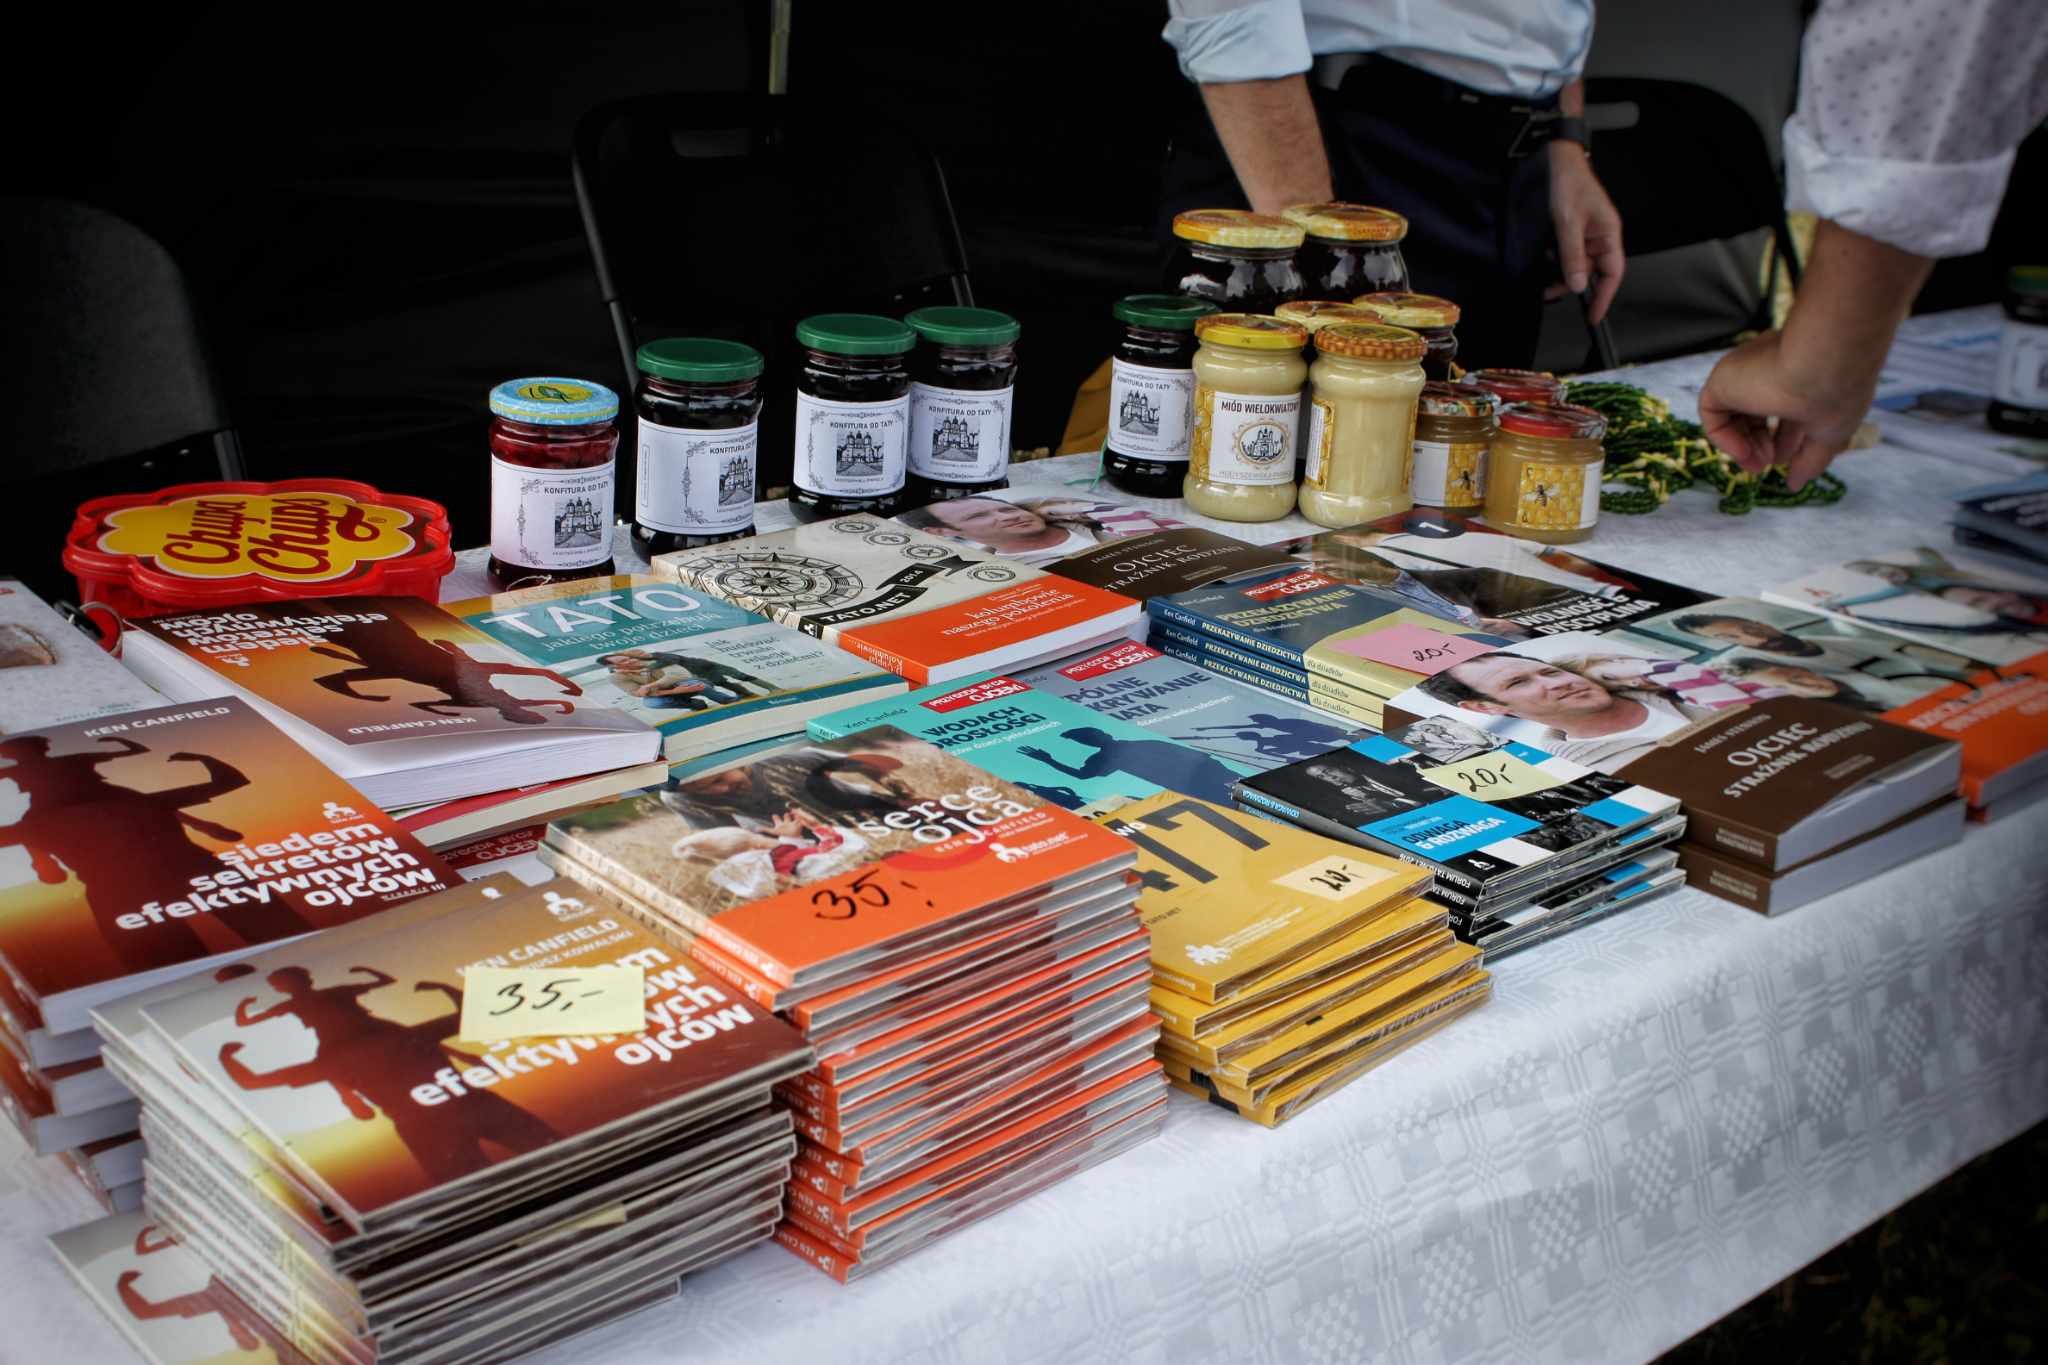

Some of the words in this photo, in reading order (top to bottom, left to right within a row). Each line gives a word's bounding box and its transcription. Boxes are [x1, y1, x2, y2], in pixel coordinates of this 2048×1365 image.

[1155, 383, 1171, 391] TATY
[928, 405, 965, 416] KONFITURA
[977, 408, 992, 416] TATY
[1221, 401, 1242, 414] MIÓD
[830, 421, 868, 429] KONFITURA
[709, 445, 745, 455] KONFITURA
[544, 486, 587, 495] KONFITURA
[163, 500, 267, 565] Chupa
[247, 498, 380, 575] Chups
[1113, 544, 1197, 572] OJCIEC
[900, 569, 924, 584] 2014
[1104, 561, 1177, 592] TRAŻNIK
[480, 588, 701, 639] TATO
[820, 592, 912, 622] TATO.NET
[1216, 588, 1356, 621] PRZEKAZYWANIE
[1232, 602, 1348, 627] DZIEDZICTWA
[1510, 596, 1615, 627] WOLNOŚĆ
[1534, 599, 1661, 636] DYSCYPLINA
[160, 612, 258, 631] ojców
[172, 613, 388, 639] efektywnych
[187, 624, 344, 646] sekretów
[200, 635, 328, 654] siedem
[542, 629, 617, 651] jakiego
[589, 636, 644, 652] twoje
[1201, 621, 1257, 647] PRZEKAZYWANIE
[1256, 641, 1302, 664] DZIEDZICTWA
[1205, 642, 1260, 668] PRZEKAZYWANIE
[1260, 661, 1307, 684] DZIEDZICTWA
[1064, 675, 1149, 703] PÓLNE
[1085, 671, 1213, 712] KRYWANIE
[1204, 658, 1259, 684] PRZEKAZYWANIE
[1260, 678, 1307, 701] DZIEDZICTWA
[84, 722, 129, 738] KEN
[131, 707, 231, 730] CANFIELD
[921, 706, 1025, 737] WODACH
[1108, 702, 1169, 721] IATA
[347, 719, 436, 735] CANFIELD
[929, 713, 1047, 749] ROSŁOŚCI
[1727, 722, 1819, 767] OJCIEC
[859, 785, 1002, 838] serce
[912, 798, 1036, 845] ojca
[984, 811, 1047, 836] CANFIELD
[217, 822, 383, 867] siedem
[1403, 820, 1472, 844] ODWAGA
[1427, 817, 1507, 846] ROZWAGA
[189, 834, 399, 893] sekretów
[115, 850, 419, 930] efektywnych
[304, 866, 438, 908] ojców
[1446, 872, 1471, 889] FORUM
[1441, 889, 1466, 905] FORUM
[1448, 913, 1463, 926] FOR
[509, 919, 620, 961] CANFIELD
[614, 1003, 755, 1066] ojców
